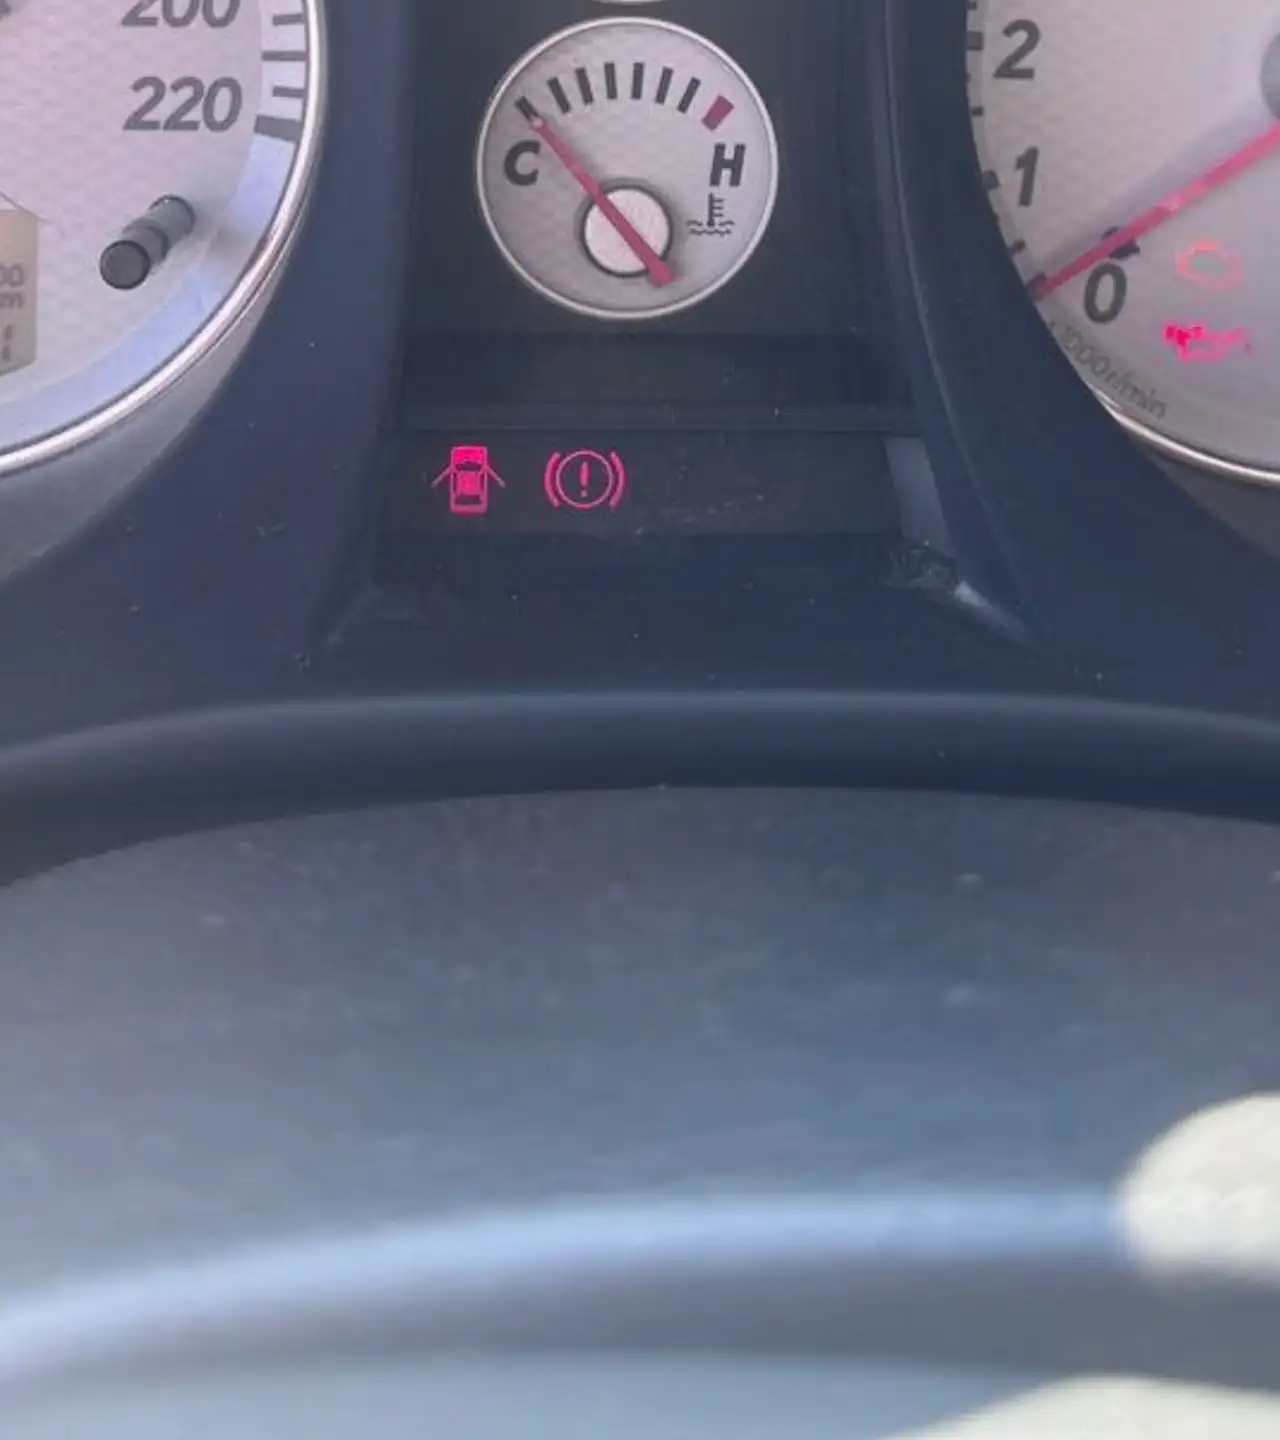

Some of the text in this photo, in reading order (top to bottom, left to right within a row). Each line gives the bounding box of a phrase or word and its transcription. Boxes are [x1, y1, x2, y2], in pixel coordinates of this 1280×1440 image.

[992, 18, 1042, 80] 2
[121, 74, 243, 133] 220
[502, 140, 541, 187] C
[709, 142, 747, 189] H
[1014, 146, 1040, 208] 1
[1083, 264, 1128, 323] 0
